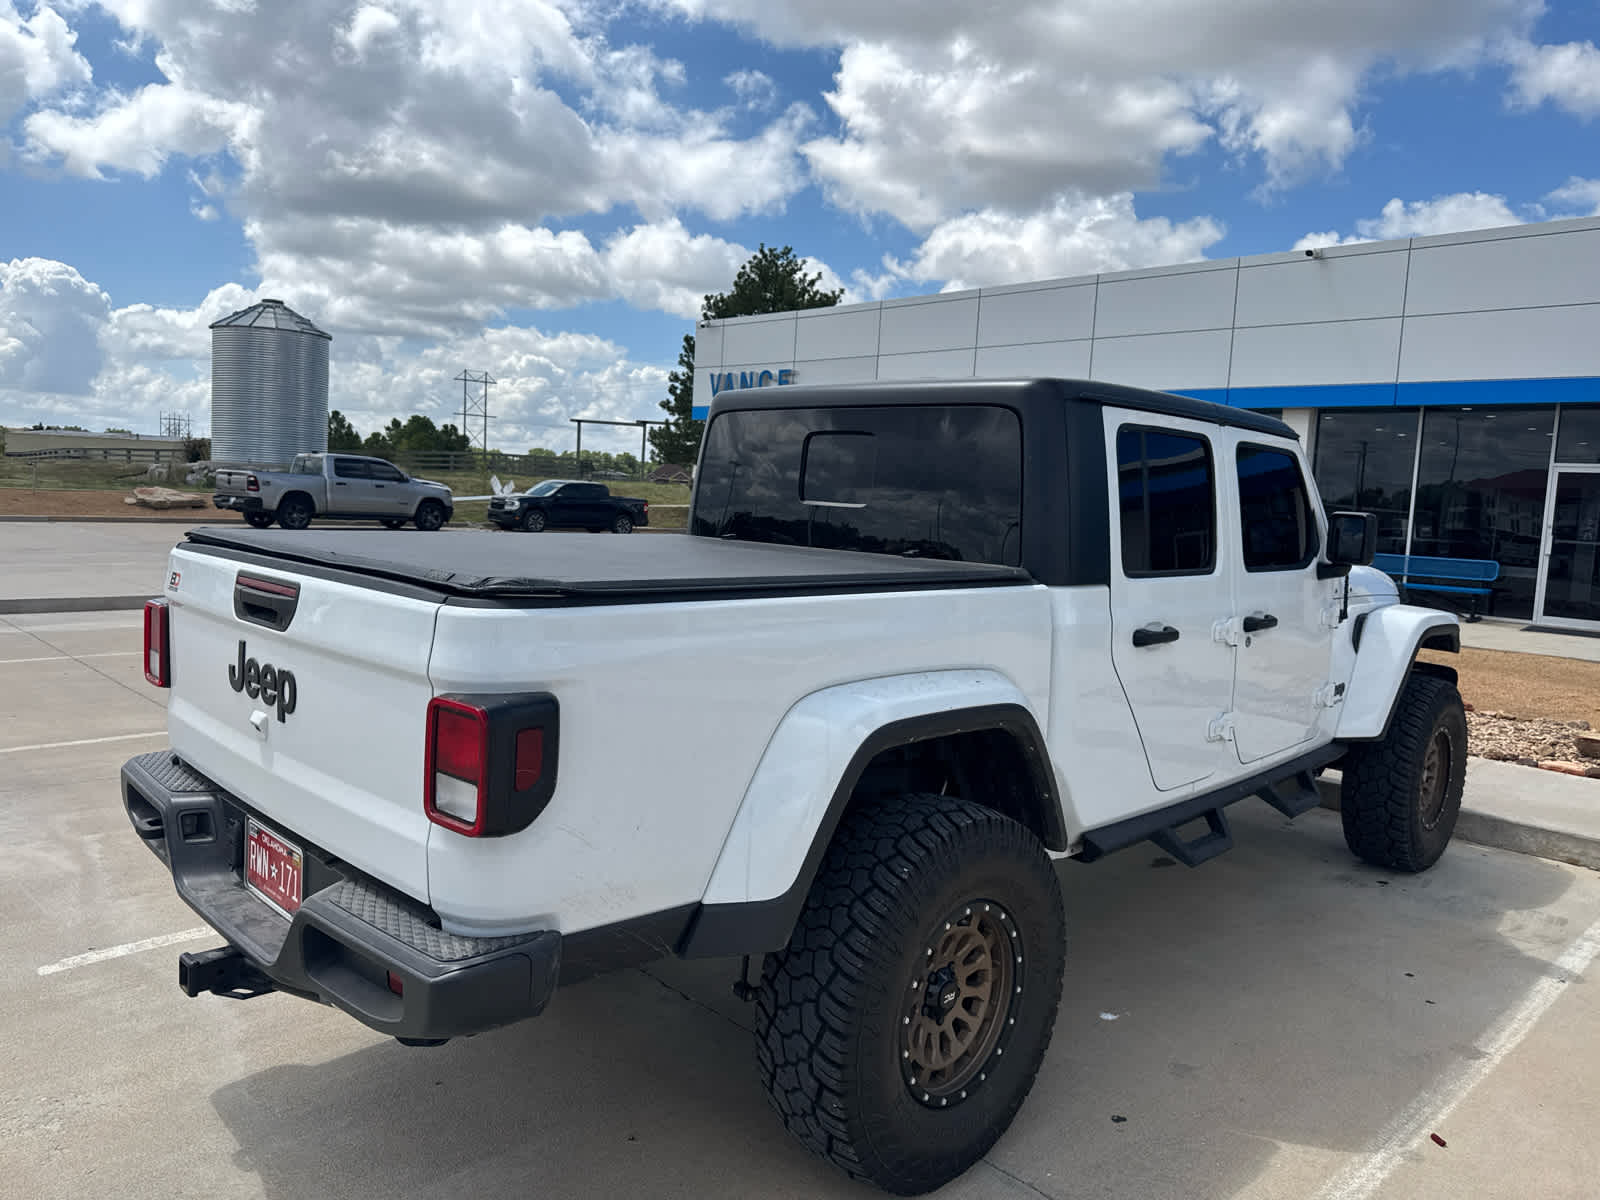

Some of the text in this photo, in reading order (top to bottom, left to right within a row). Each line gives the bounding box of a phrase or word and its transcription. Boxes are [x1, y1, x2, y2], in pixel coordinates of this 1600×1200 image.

[709, 368, 793, 398] VANCE
[228, 639, 297, 724] Jeep
[278, 860, 298, 903] 171
